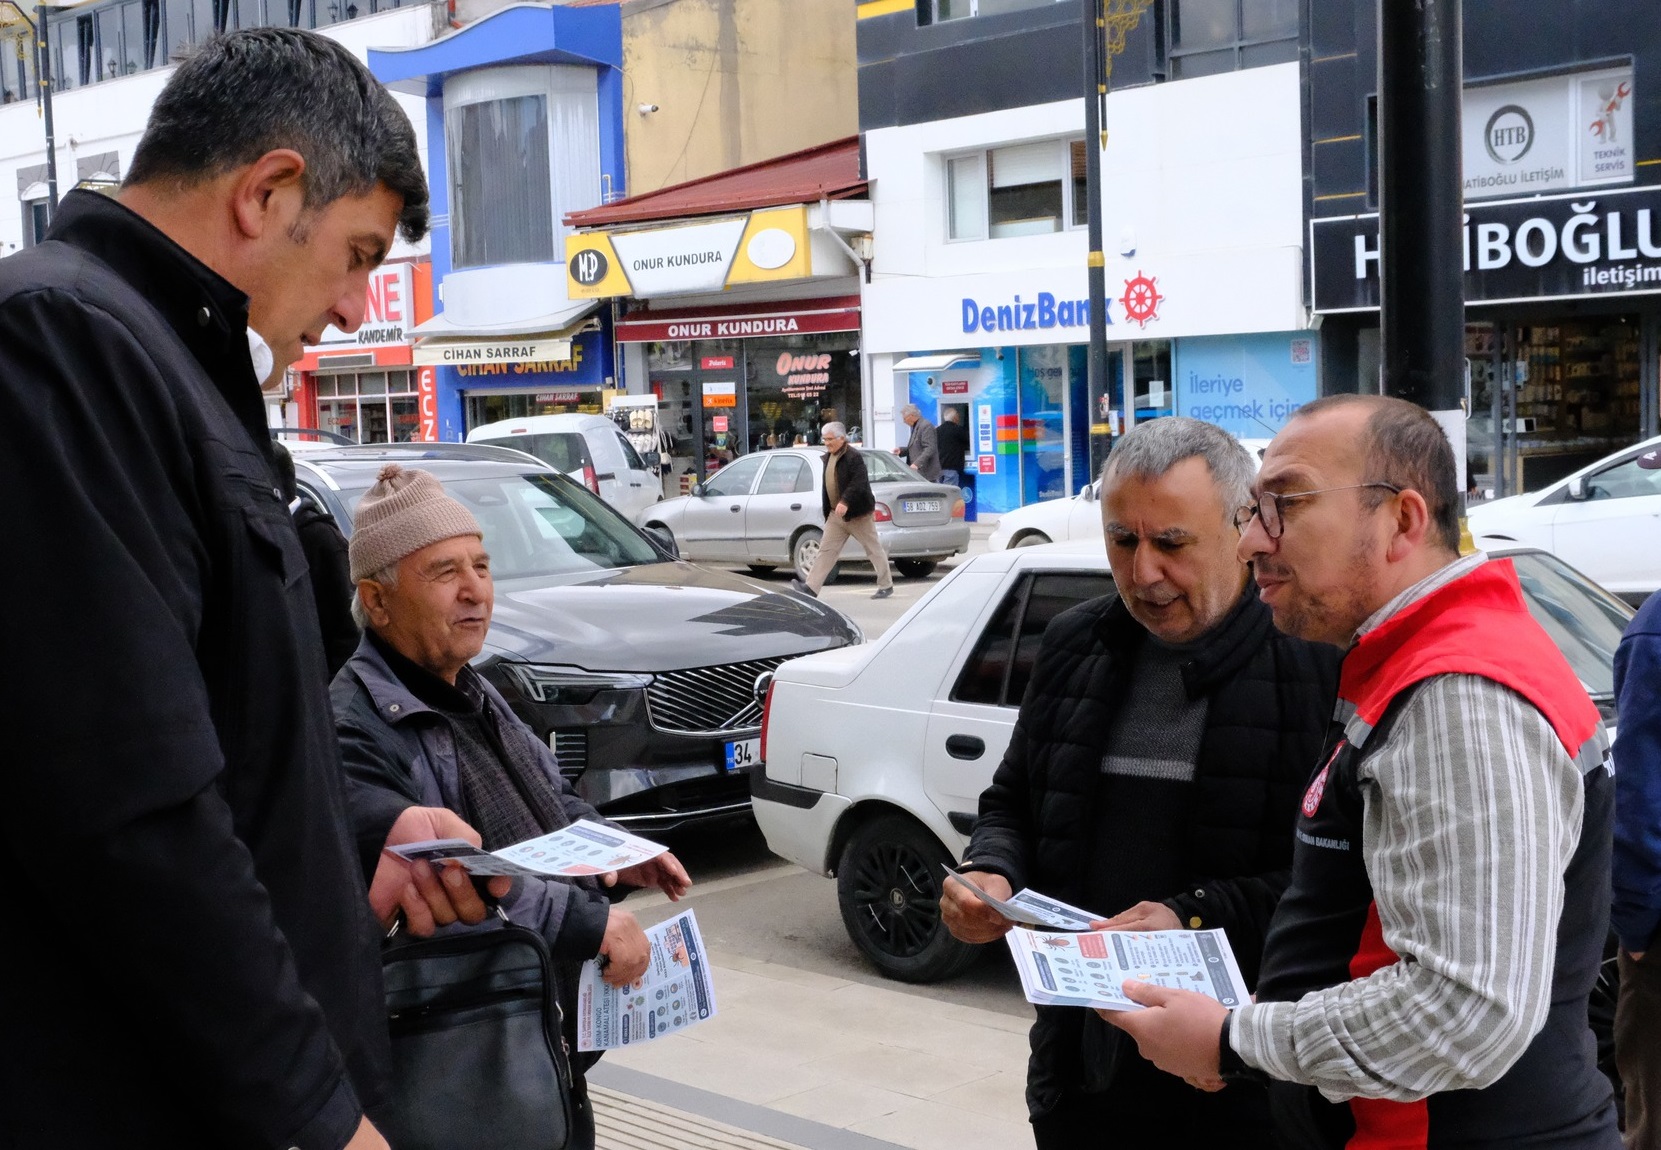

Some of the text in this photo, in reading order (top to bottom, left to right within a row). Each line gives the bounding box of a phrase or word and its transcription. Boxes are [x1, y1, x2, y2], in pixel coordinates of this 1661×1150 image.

[1494, 126, 1526, 147] HTB
[1594, 146, 1626, 160] TEKNİK
[1595, 160, 1625, 173] SERVİS
[1463, 166, 1565, 190] ATİBOĞLU İLETİŞİM
[1354, 201, 1661, 279] HİBOĞLU
[633, 251, 723, 271] ONUR KUNDURA
[1583, 264, 1661, 288] iletişim
[358, 325, 403, 344] KANDEMİR
[668, 318, 799, 337] ONUR KUNDURA
[443, 346, 536, 360] CİHAN SARRAF
[787, 372, 830, 386] KUNDURA
[1190, 370, 1244, 397] İleriye
[421, 370, 435, 442] ECZ
[1190, 399, 1264, 422] geçmek
[735, 743, 752, 765] 34
